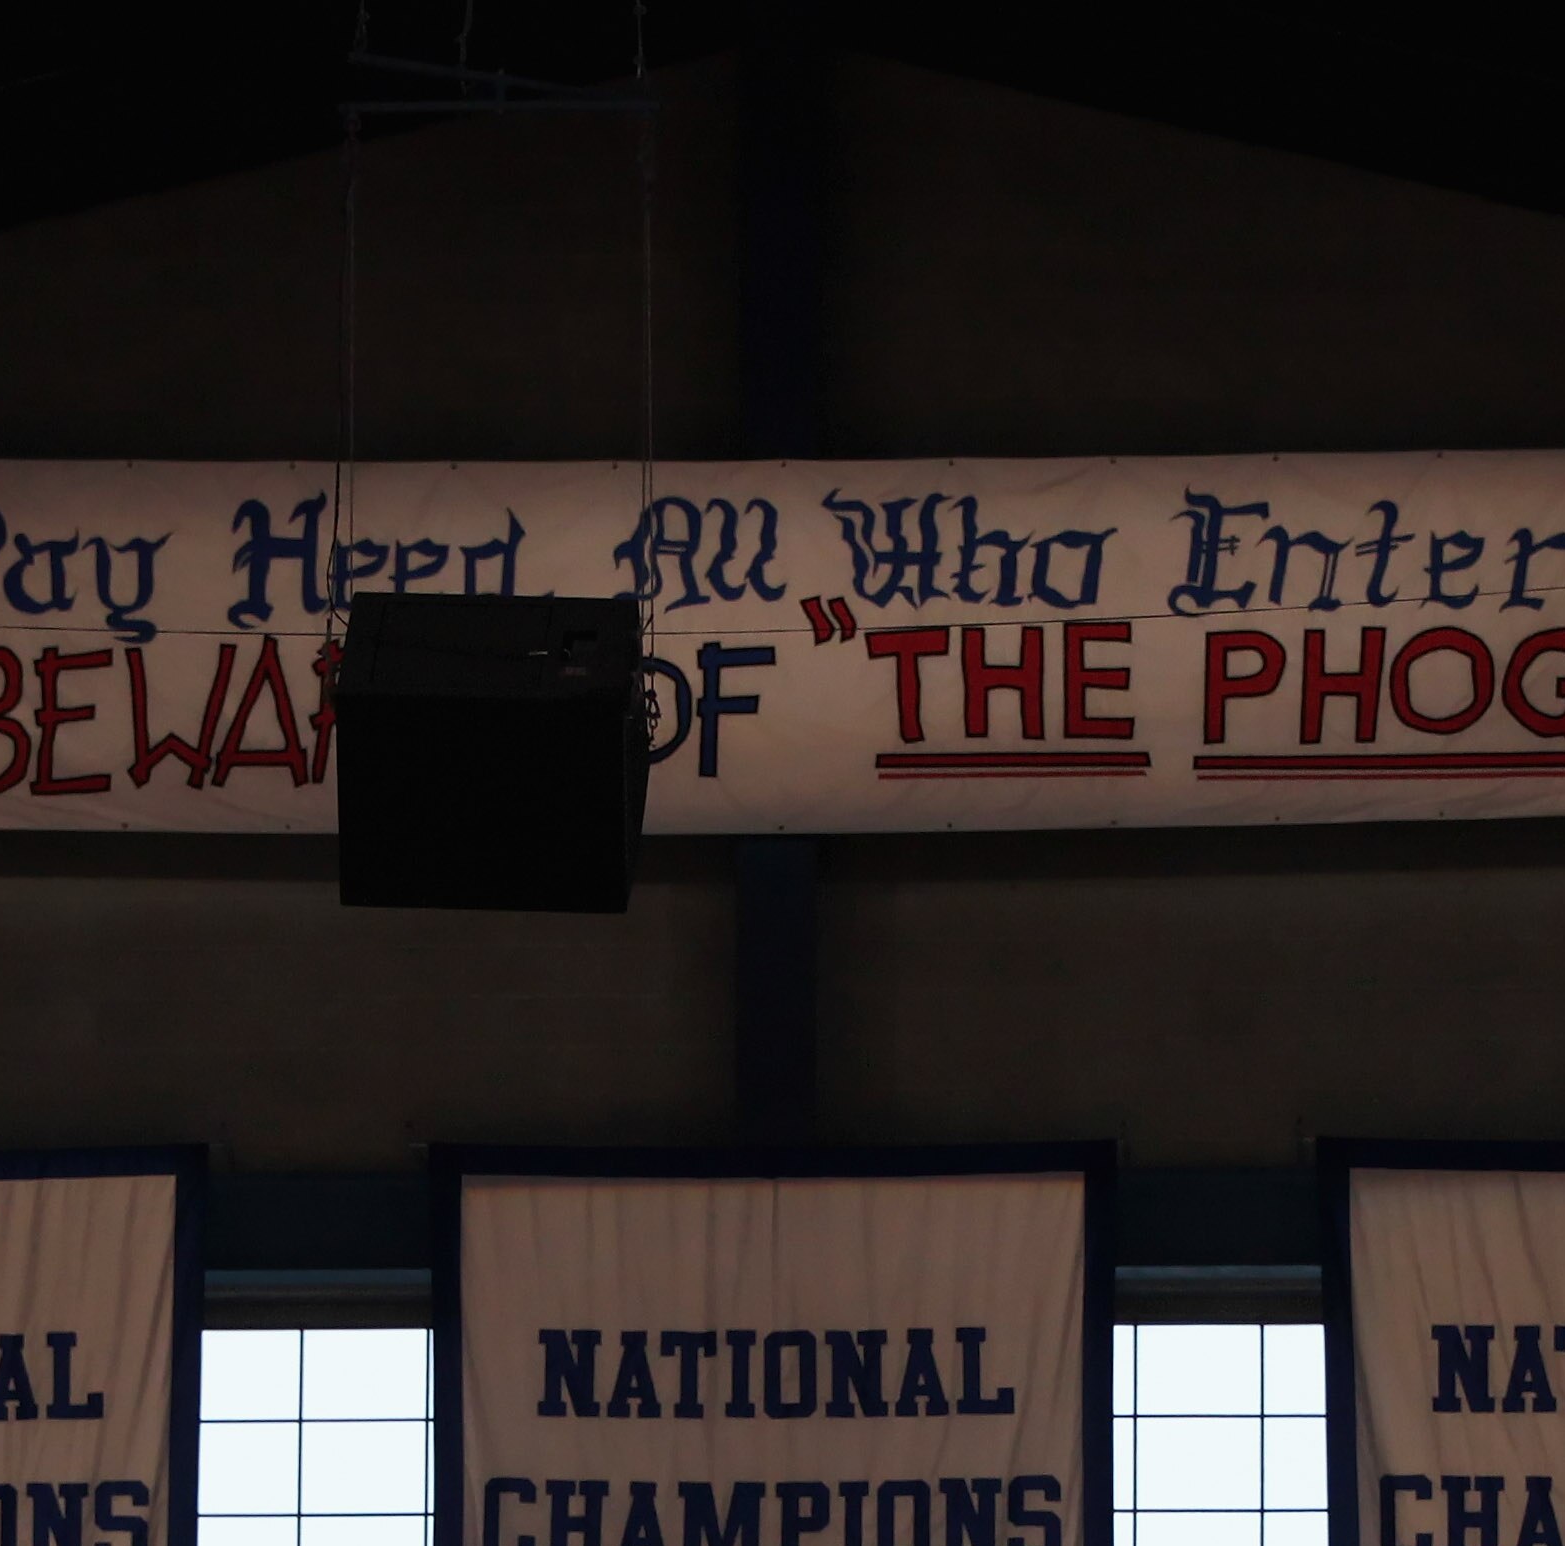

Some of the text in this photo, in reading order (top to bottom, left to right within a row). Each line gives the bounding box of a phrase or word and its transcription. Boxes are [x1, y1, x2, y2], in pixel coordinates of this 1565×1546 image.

[611, 495, 789, 613] All
[822, 489, 1119, 608] Who
[537, 1327, 1015, 1419] NATIONAL
